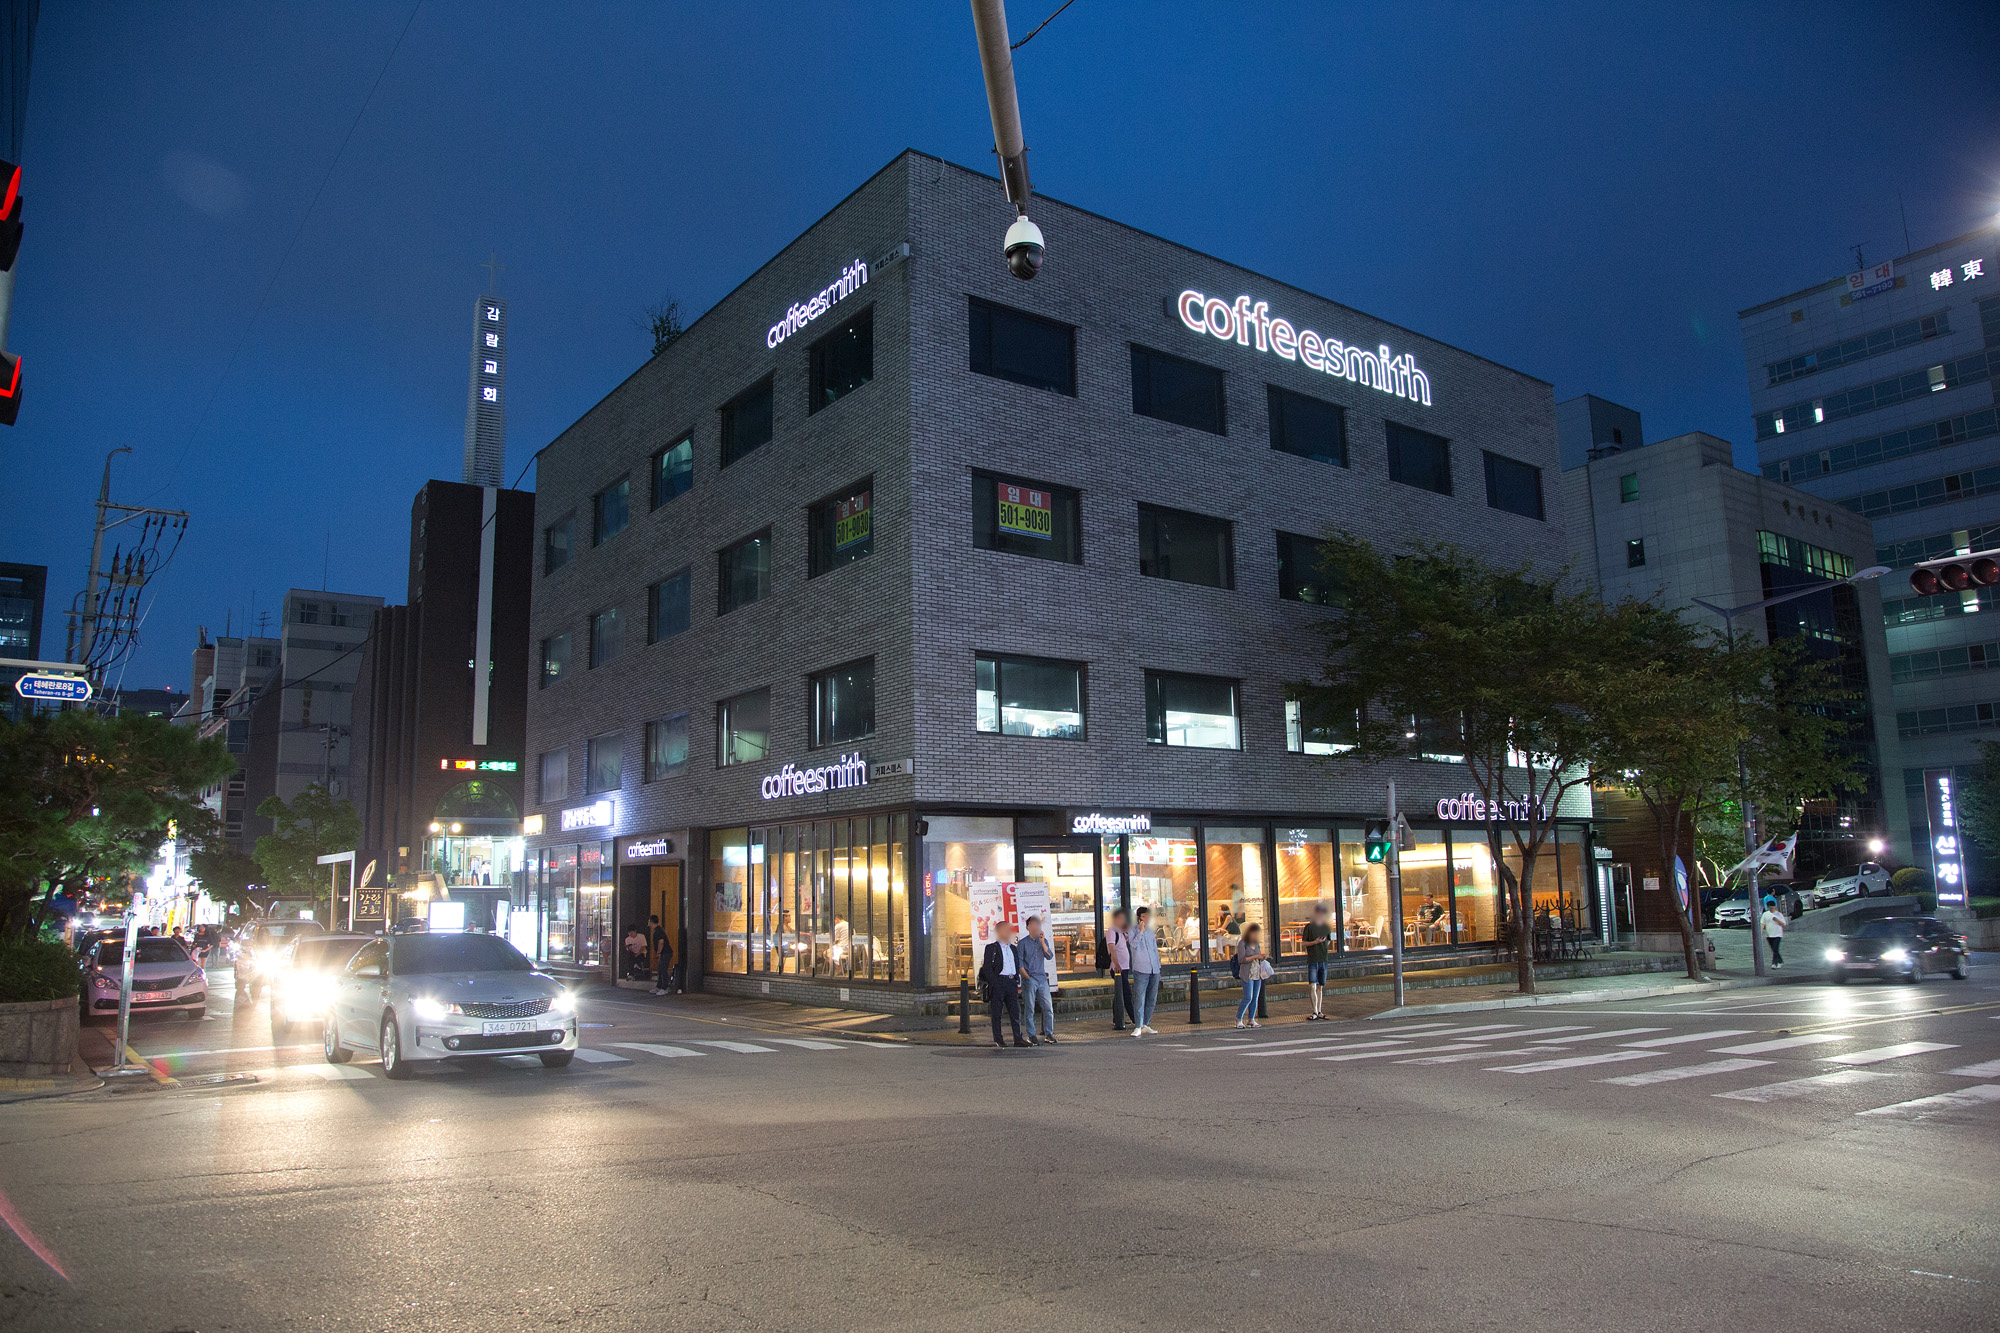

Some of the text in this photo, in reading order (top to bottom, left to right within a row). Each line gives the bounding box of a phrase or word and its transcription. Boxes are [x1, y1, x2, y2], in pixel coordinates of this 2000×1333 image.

[1929, 258, 1985, 291] 韓東
[767, 258, 868, 349] coffeesmith
[482, 306, 500, 402] 감람교회
[1178, 290, 1432, 406] coffeesmith
[837, 511, 868, 543] 501-9030
[1000, 503, 1050, 532] 501-9030
[23, 682, 32, 690] 21
[33, 681, 74, 691] 테헤란로8길
[762, 752, 868, 799] coffeesmith
[1073, 813, 1150, 831] coffeesmith
[627, 838, 667, 858] coffeesmith
[510, 1021, 531, 1031] 0721
